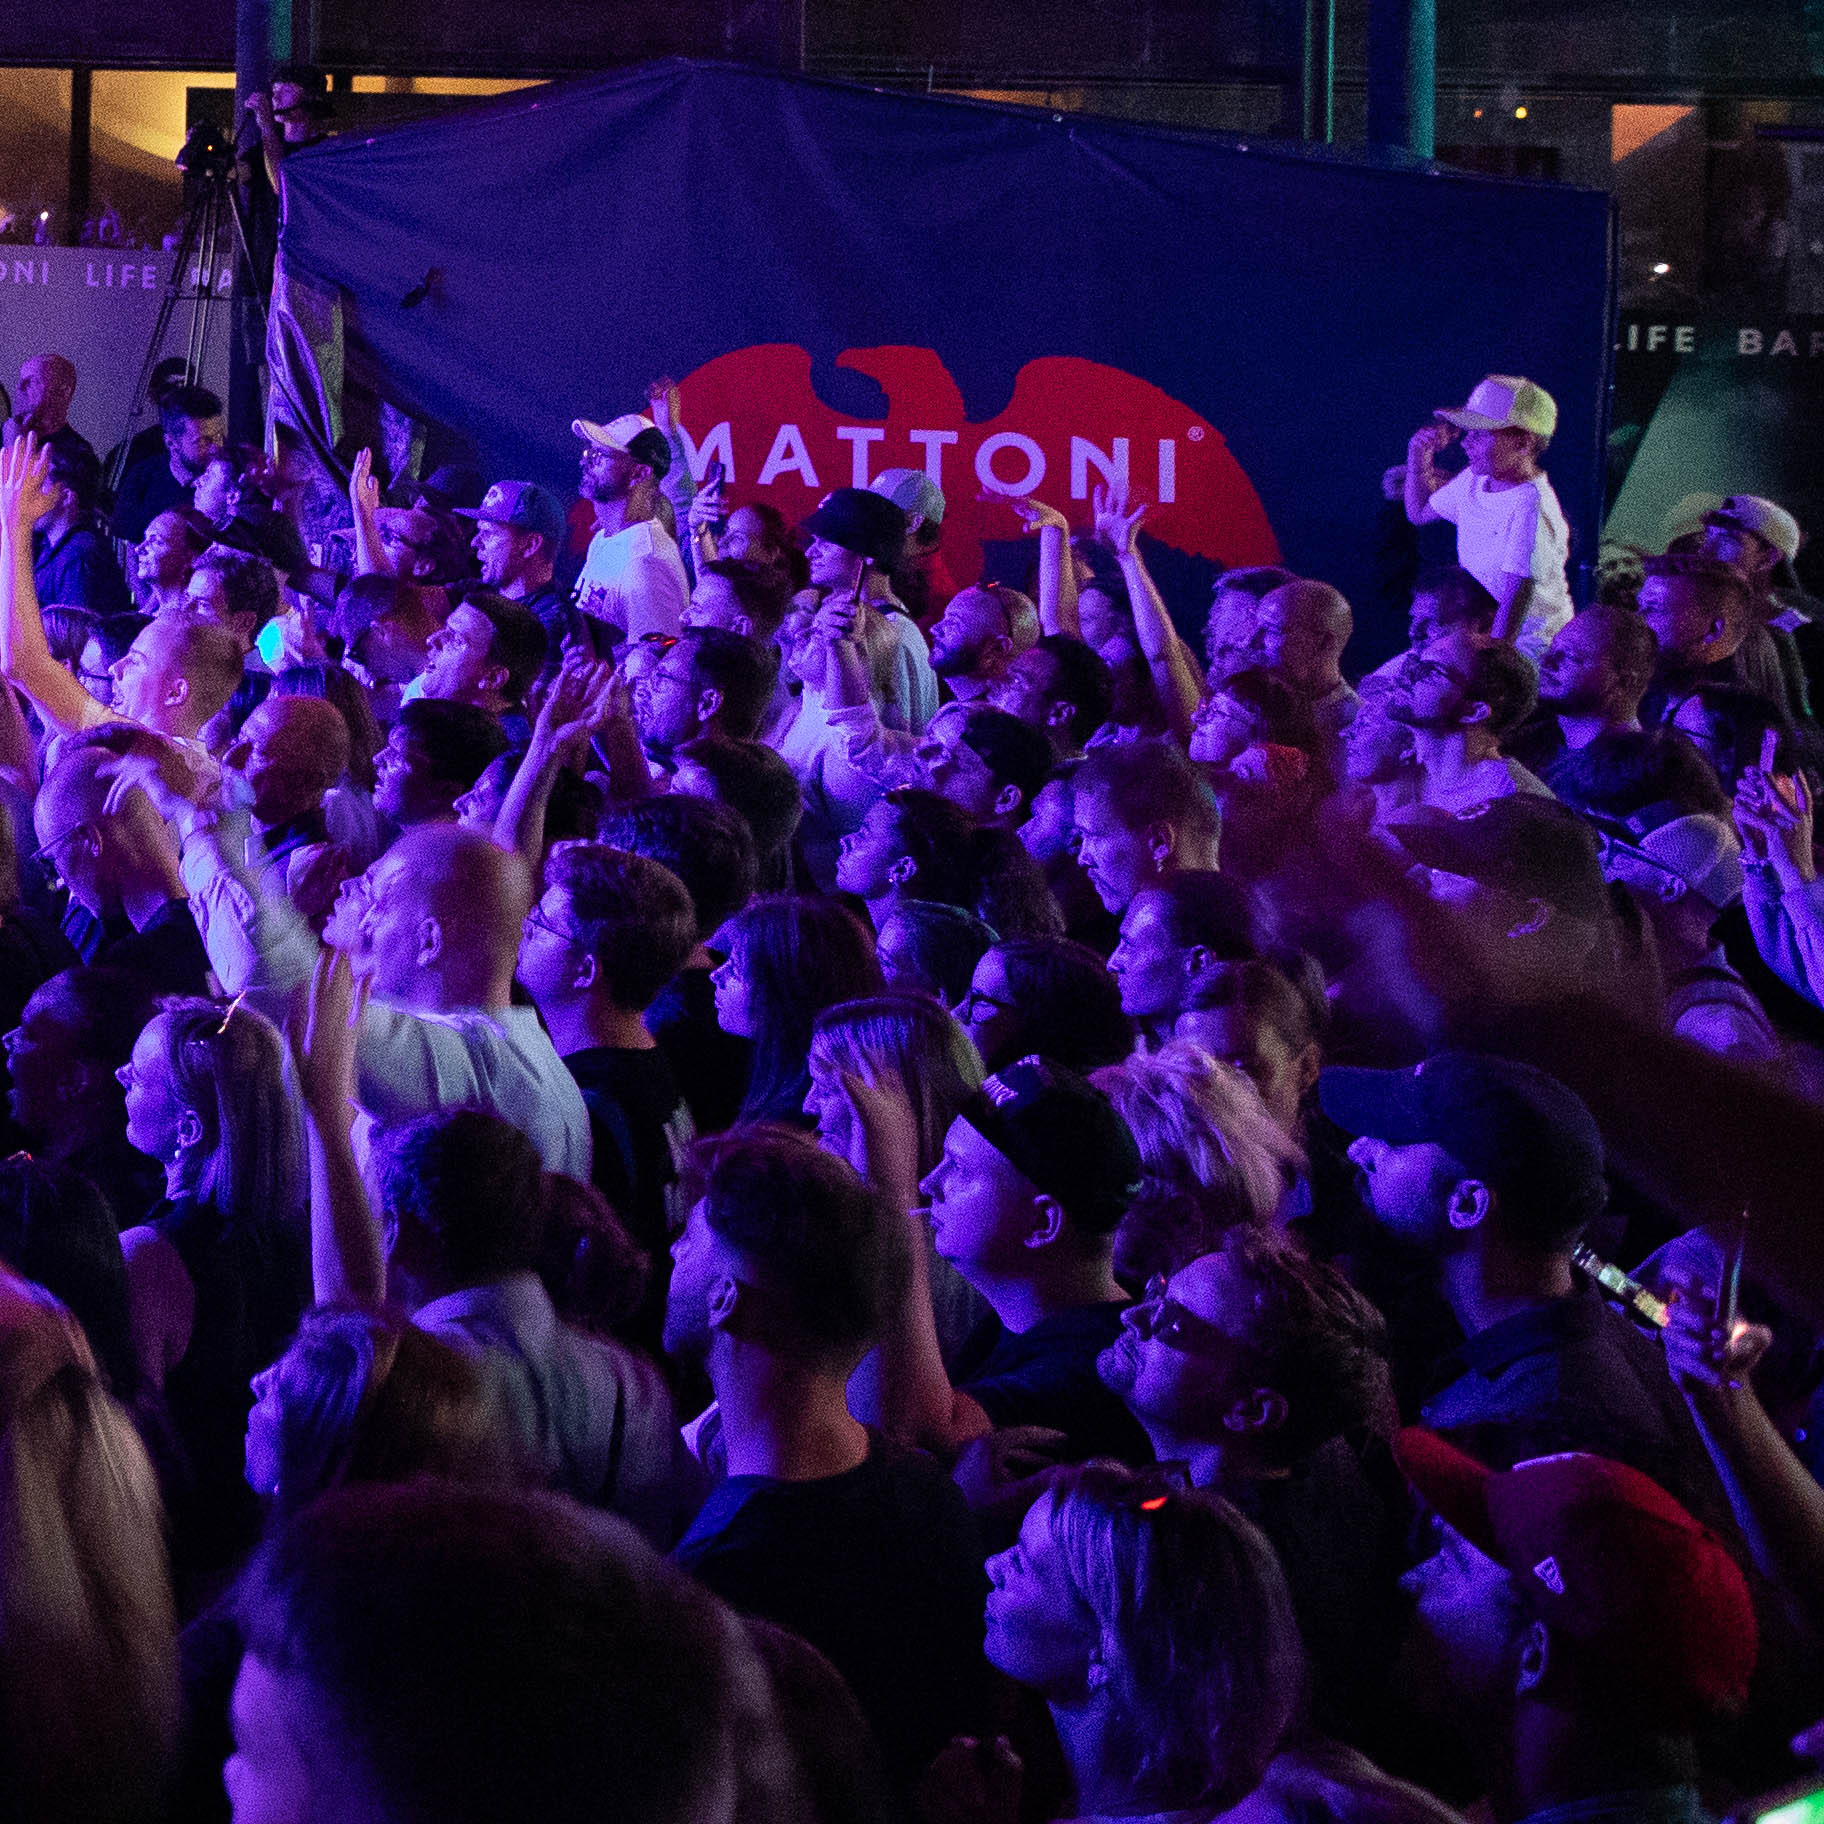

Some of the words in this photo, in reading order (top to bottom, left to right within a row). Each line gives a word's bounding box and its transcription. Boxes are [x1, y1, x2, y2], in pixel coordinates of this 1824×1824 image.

[86, 262, 157, 290] LIFE
[191, 267, 232, 292] BA
[1613, 322, 1696, 354] IFE
[675, 421, 1175, 504] MATTONI
